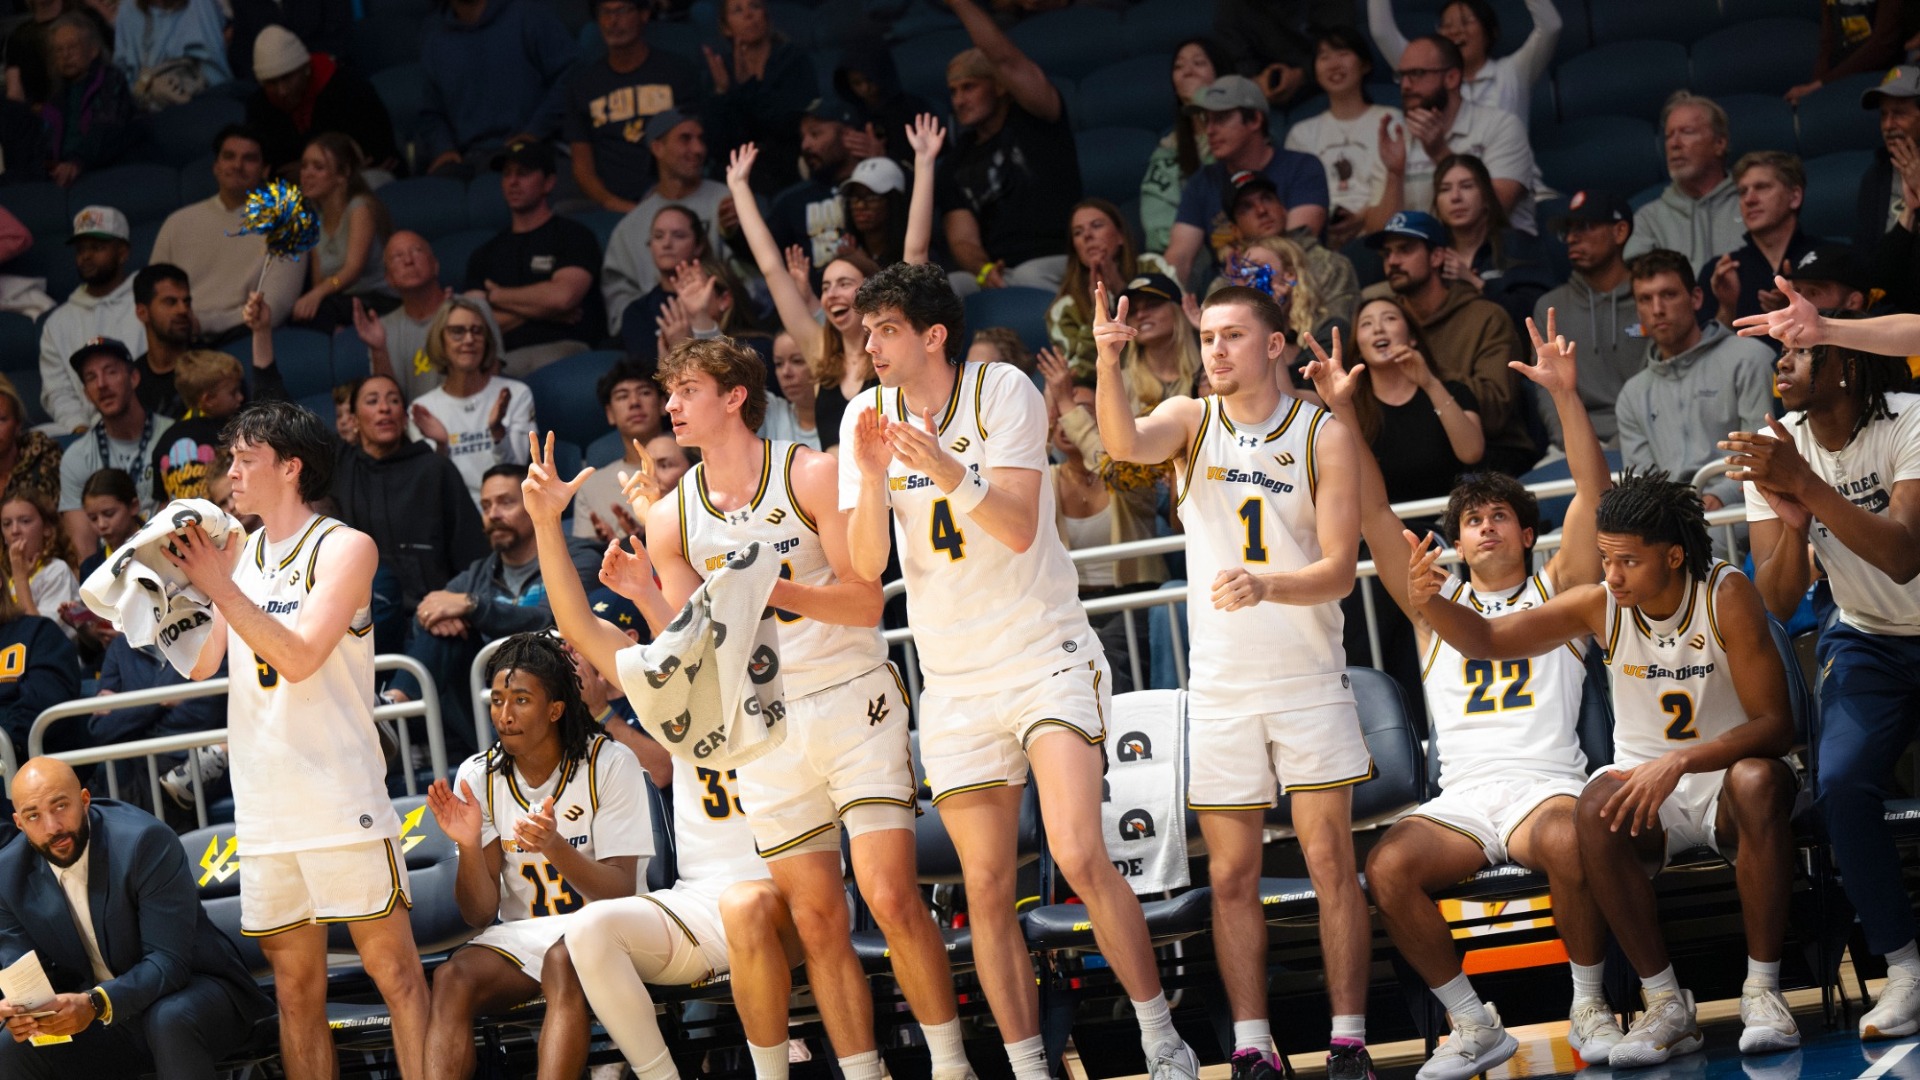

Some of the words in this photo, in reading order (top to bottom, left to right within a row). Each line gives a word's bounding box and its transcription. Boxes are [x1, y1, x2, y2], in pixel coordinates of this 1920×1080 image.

[930, 497, 966, 564] 4
[1237, 497, 1270, 564] 1
[1463, 657, 1535, 716] 22
[1660, 690, 1700, 742] 2
